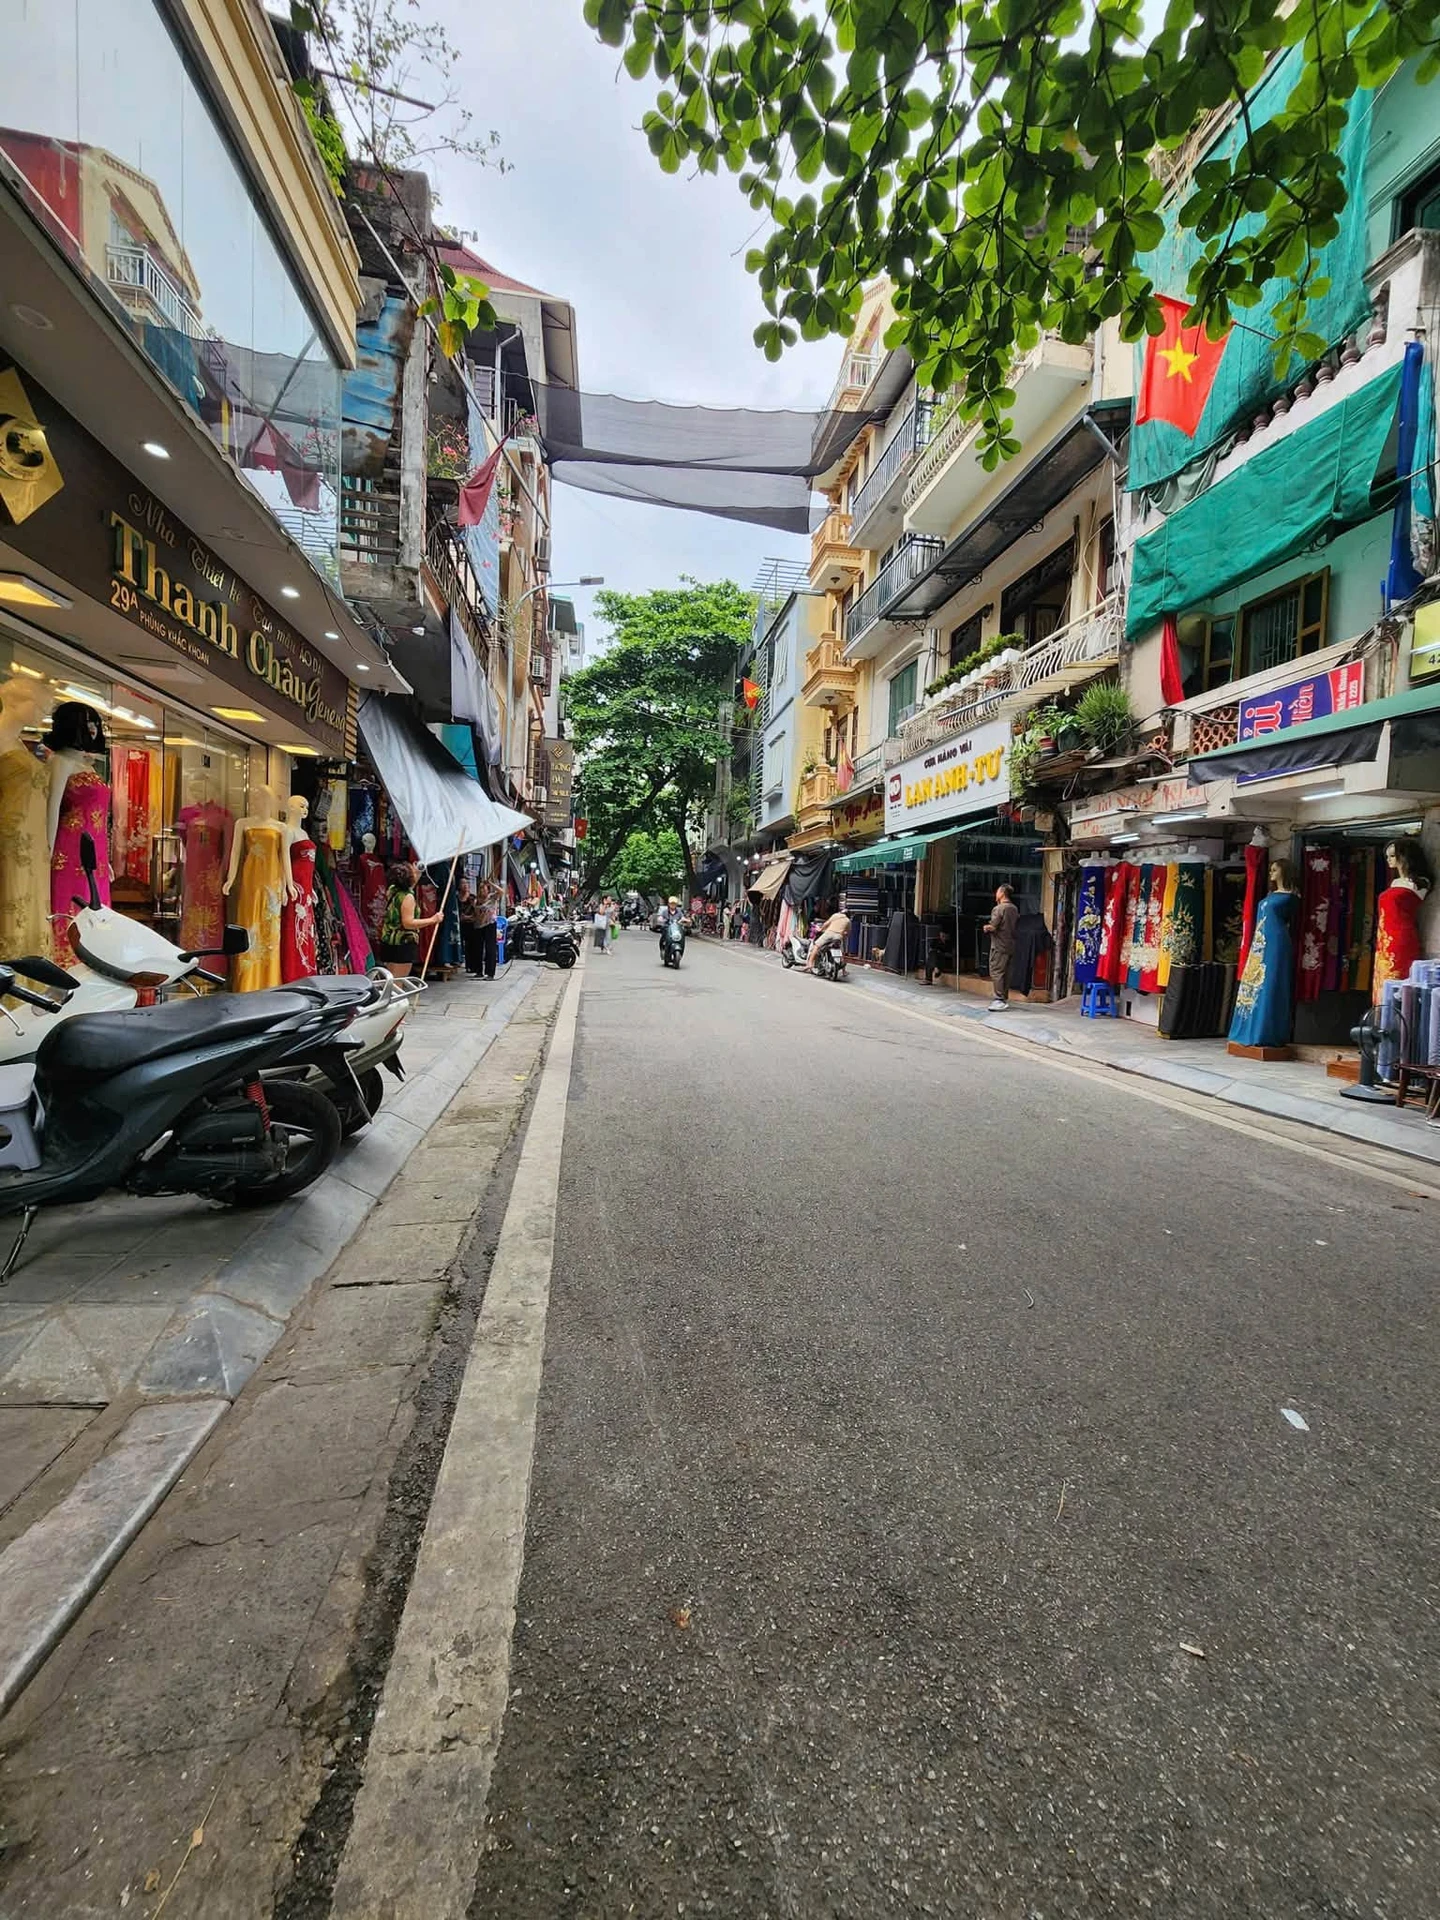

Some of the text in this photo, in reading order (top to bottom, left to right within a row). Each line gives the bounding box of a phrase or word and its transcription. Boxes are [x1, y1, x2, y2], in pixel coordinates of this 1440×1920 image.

[110, 510, 239, 660] Thanh
[249, 630, 307, 708] Châu
[110, 579, 139, 613] 29A
[139, 610, 167, 637] PHÙNG
[187, 642, 211, 665] KHOAN
